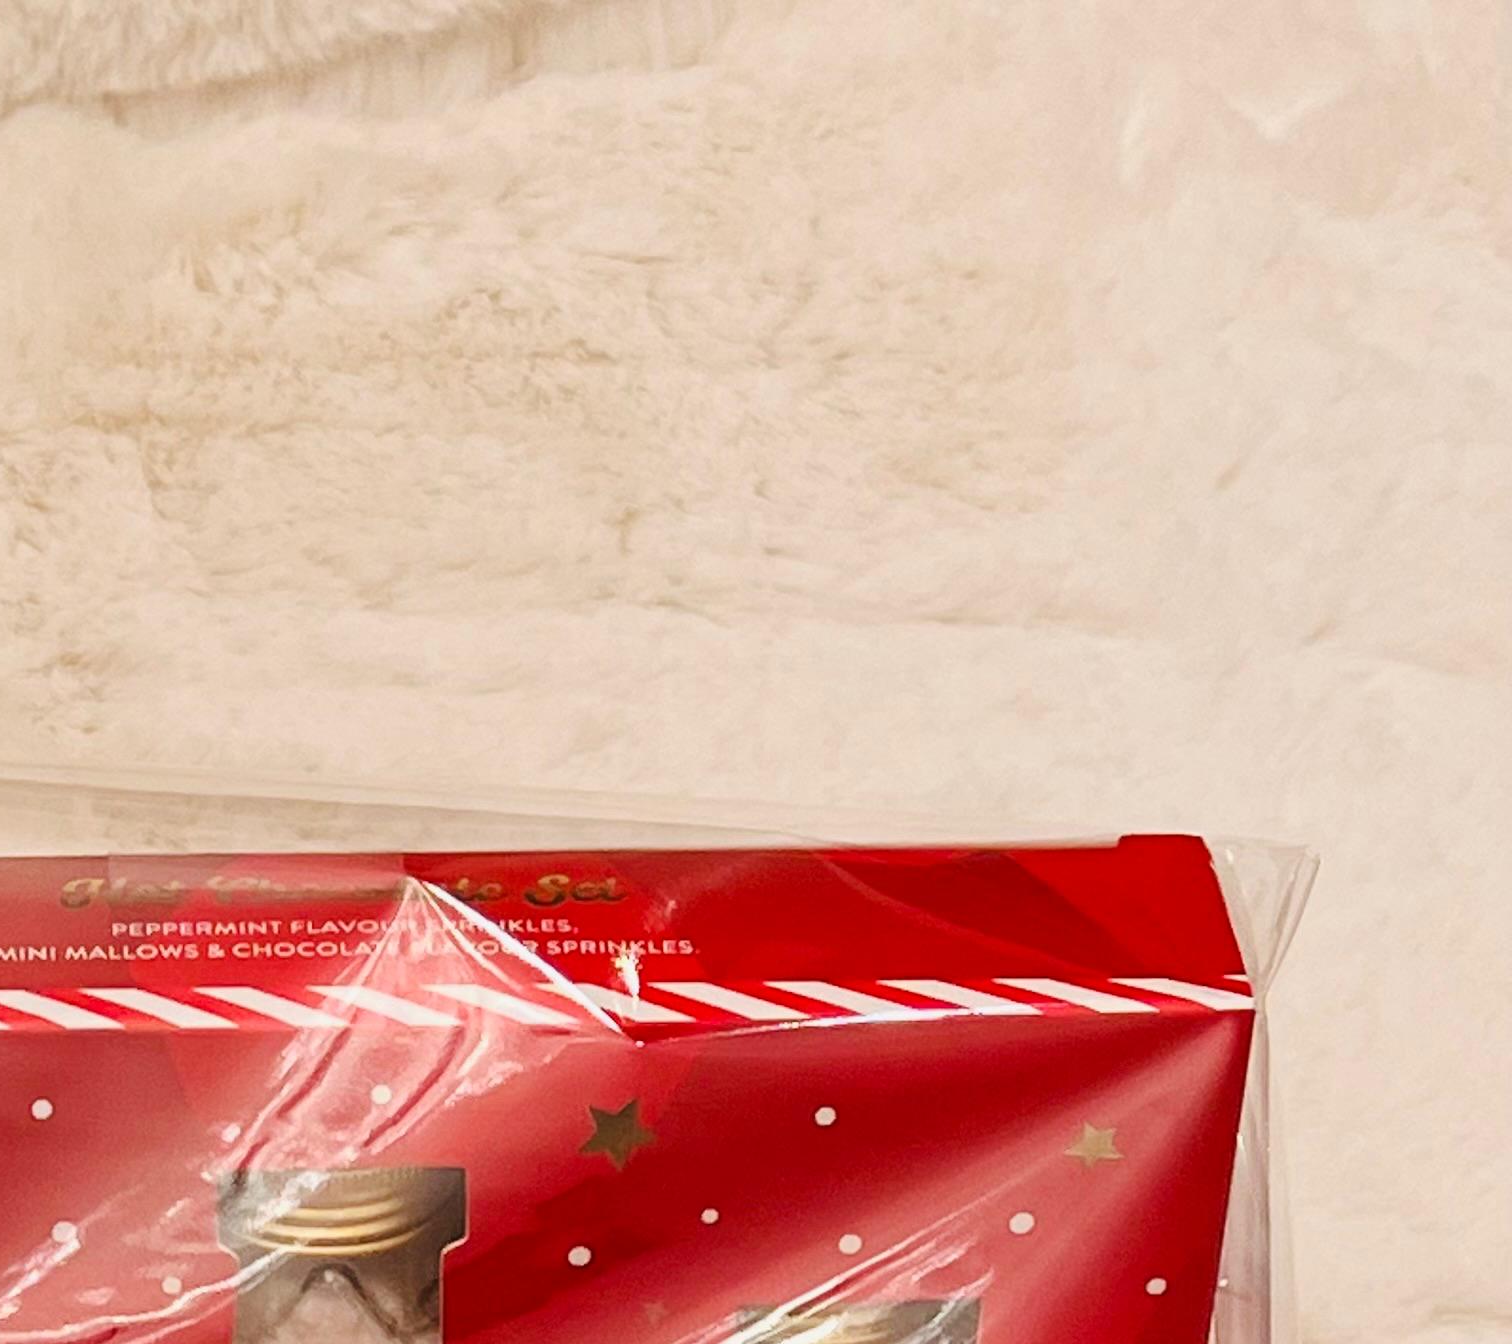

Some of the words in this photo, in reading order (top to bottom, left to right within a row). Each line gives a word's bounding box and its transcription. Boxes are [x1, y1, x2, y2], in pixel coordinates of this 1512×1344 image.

[523, 873, 627, 908] Set
[111, 920, 282, 938] PEPPERMINT
[431, 917, 580, 934] RKLES,
[65, 943, 200, 961] MALLOWS
[207, 943, 226, 958] &
